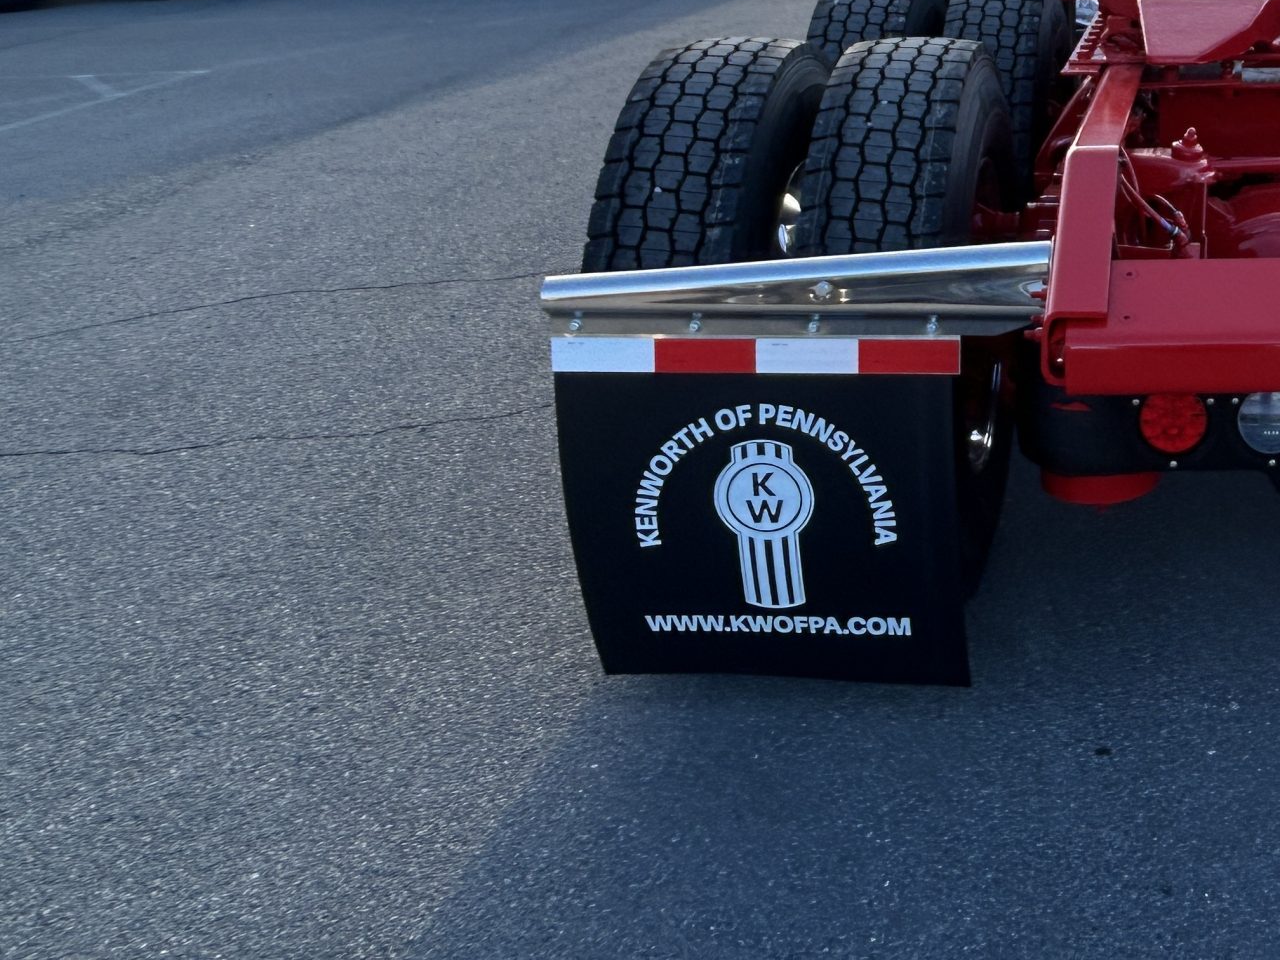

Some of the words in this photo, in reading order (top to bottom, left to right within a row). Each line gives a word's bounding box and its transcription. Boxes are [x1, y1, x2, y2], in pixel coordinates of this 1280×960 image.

[635, 418, 714, 547] KENWORTH
[715, 404, 752, 431] OF
[759, 404, 898, 546] PENNSYLVANIA
[752, 472, 774, 496] K
[746, 500, 783, 523] W
[645, 615, 912, 636] WWW.KWOFPA.COM
